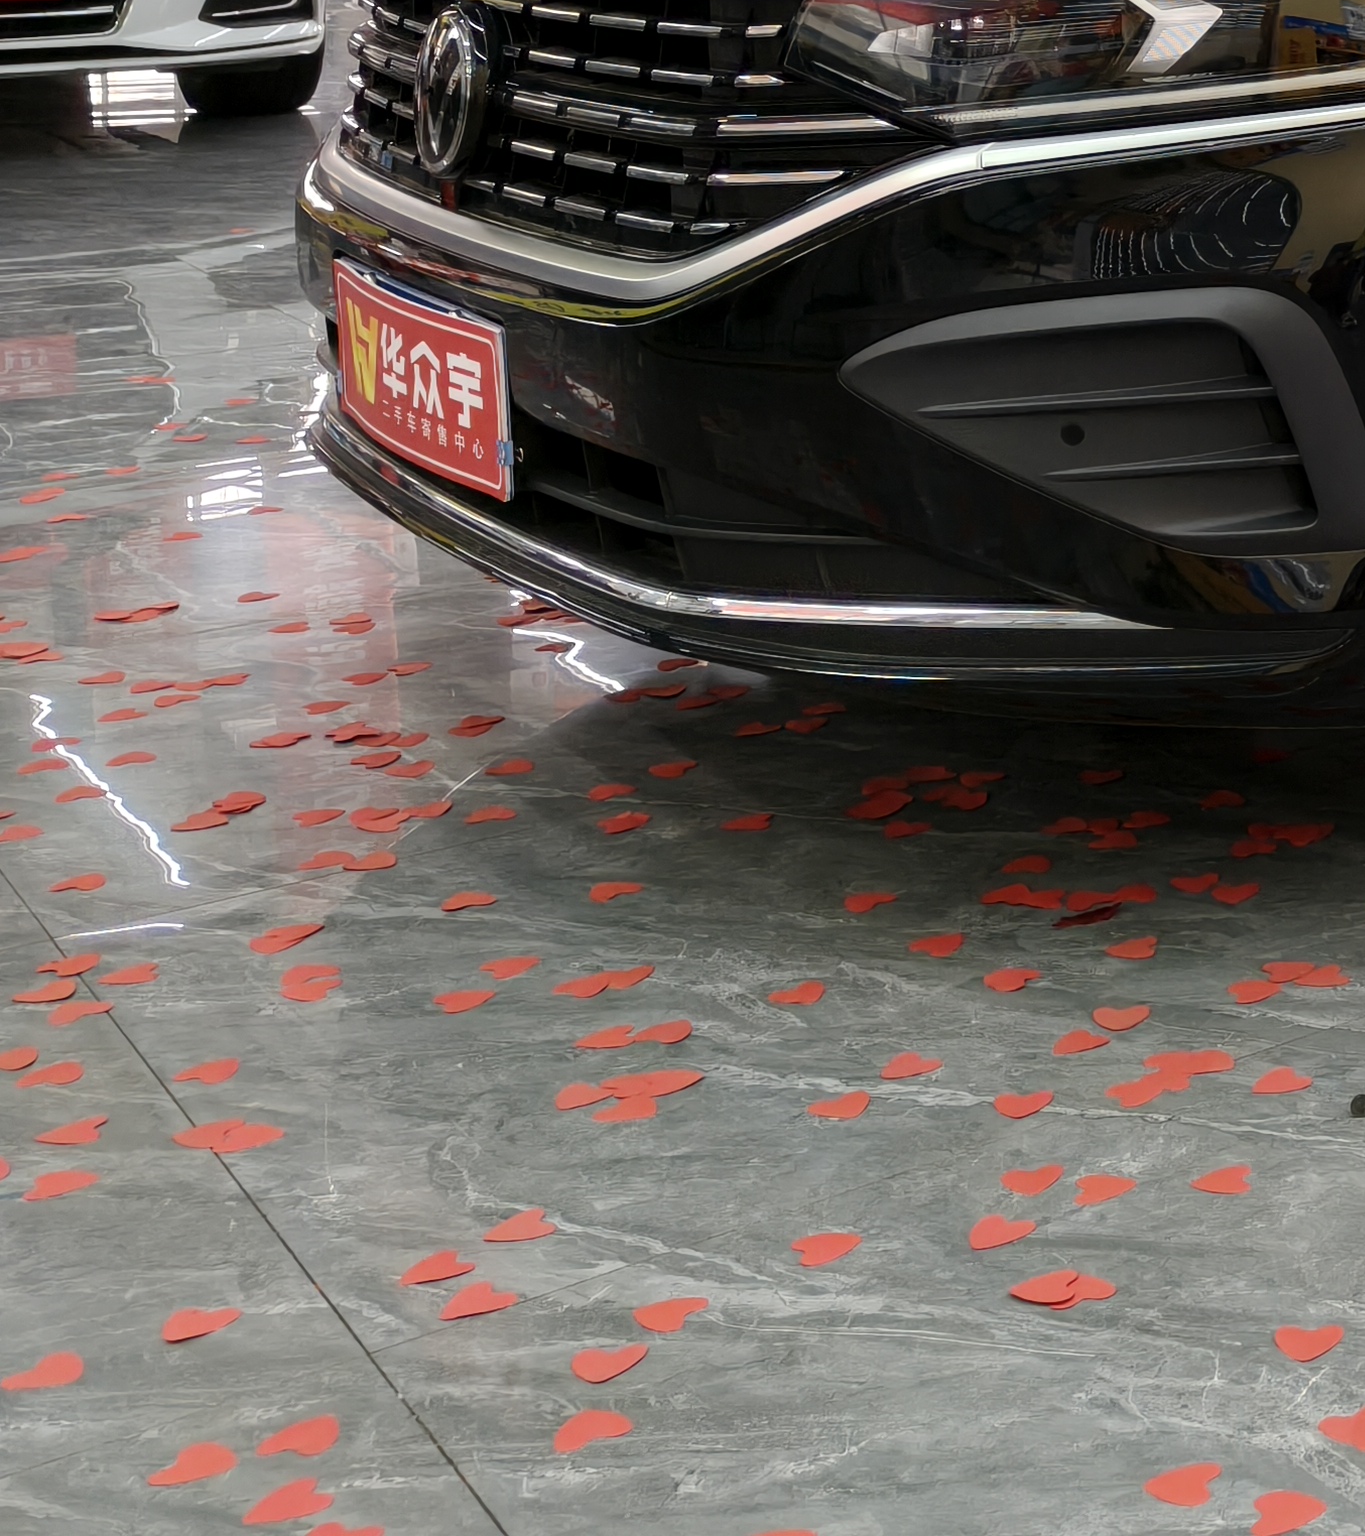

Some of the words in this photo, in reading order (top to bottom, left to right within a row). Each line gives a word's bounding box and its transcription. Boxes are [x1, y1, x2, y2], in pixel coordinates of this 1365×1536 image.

[380, 322, 484, 430] 华众宇
[382, 399, 485, 461] 二手车寄售中心
